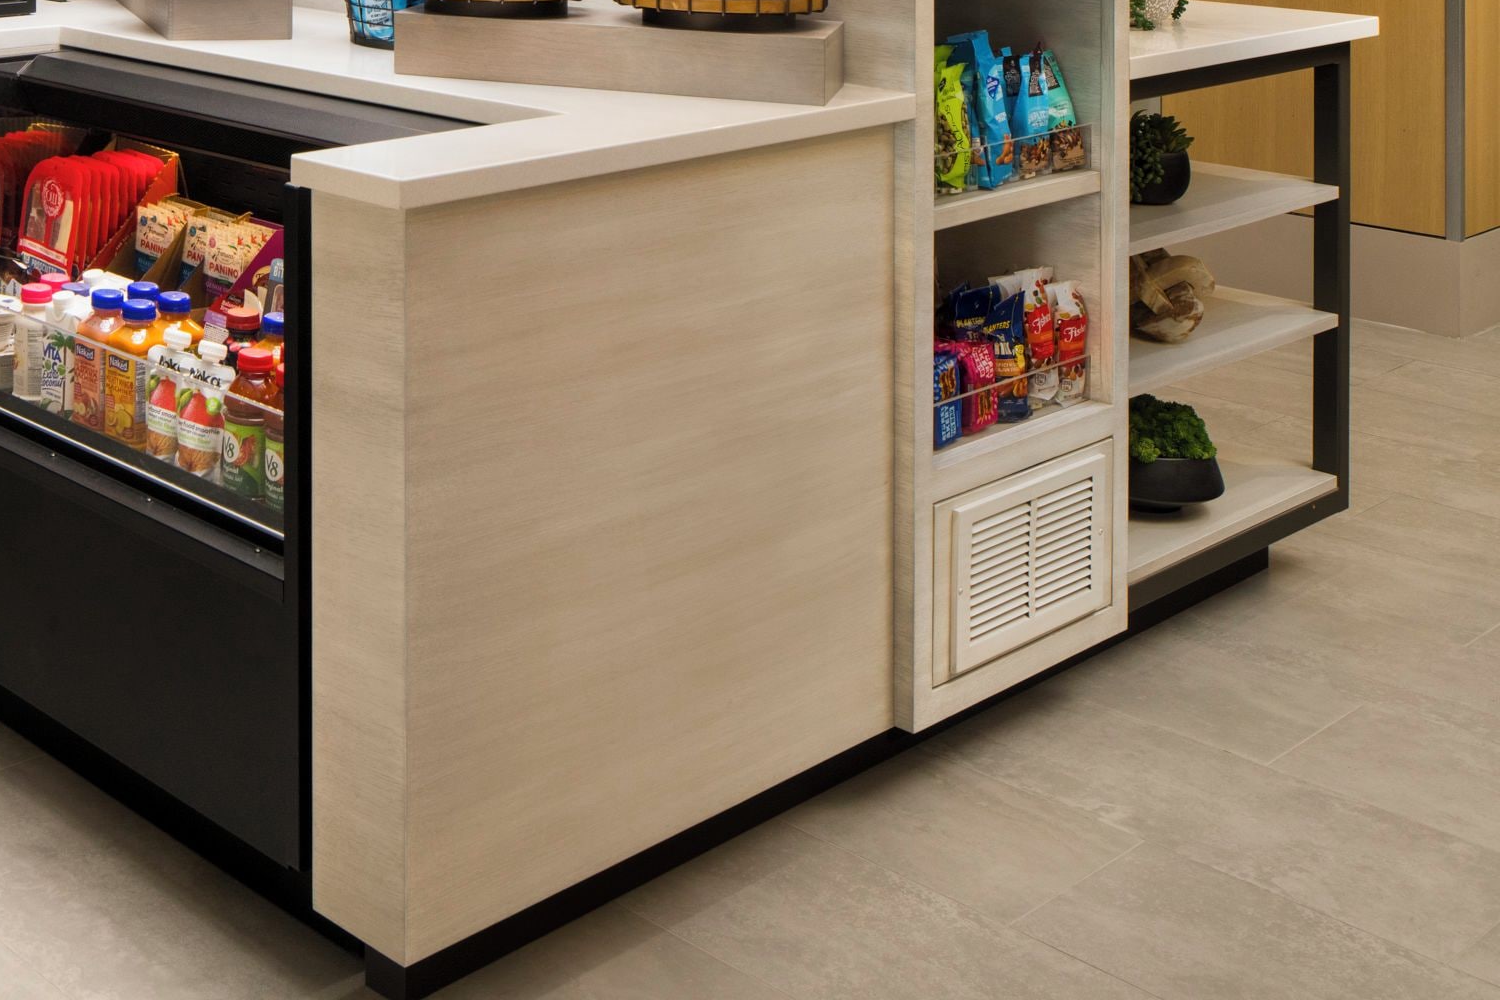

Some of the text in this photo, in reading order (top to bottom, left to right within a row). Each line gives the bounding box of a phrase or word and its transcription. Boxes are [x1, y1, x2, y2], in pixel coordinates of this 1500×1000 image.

[186, 250, 205, 264] PAN
[208, 261, 239, 280] PANINO
[43, 342, 62, 363] VITA
[76, 344, 95, 360] Naked
[109, 355, 128, 372] Naked
[224, 435, 235, 459] V8
[266, 455, 278, 477] V8
